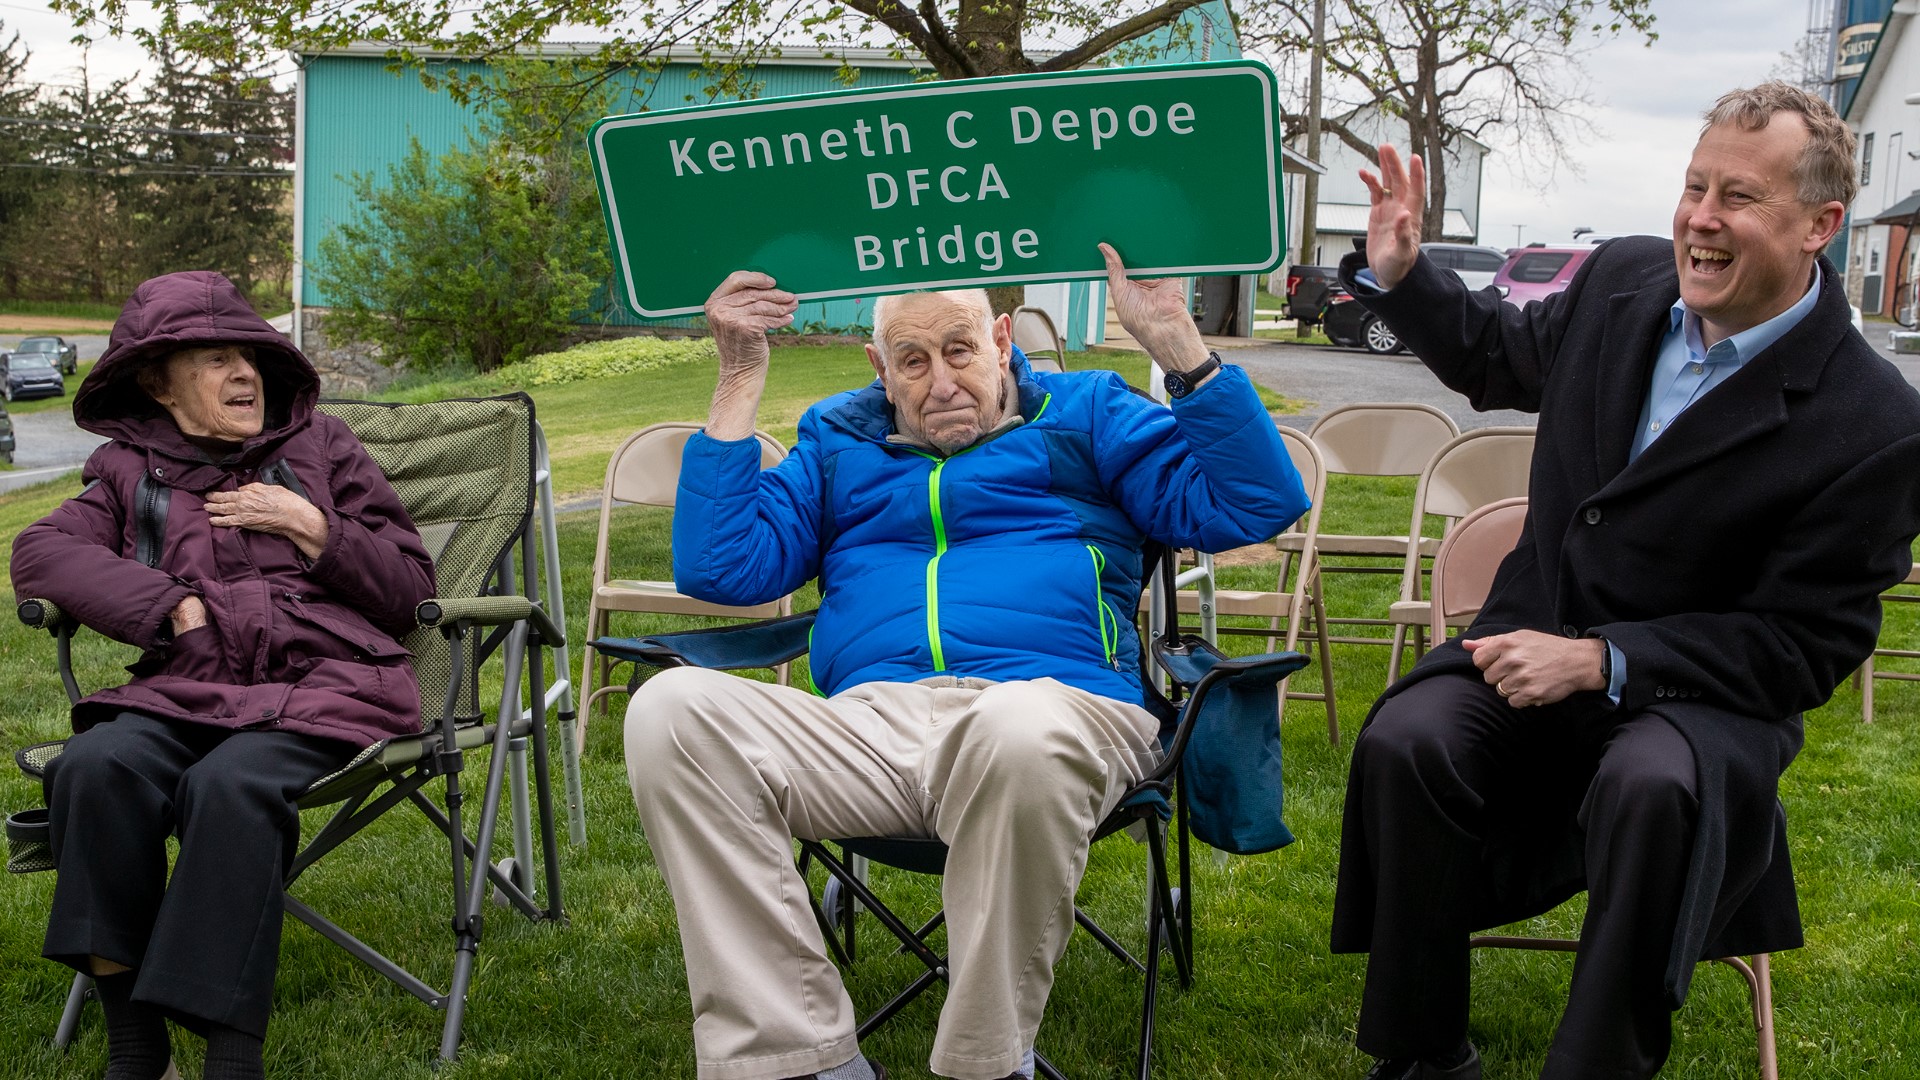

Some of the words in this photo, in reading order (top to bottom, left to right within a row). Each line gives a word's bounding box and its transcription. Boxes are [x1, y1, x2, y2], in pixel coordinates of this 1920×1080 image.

[669, 114, 912, 177] Kenneth
[946, 110, 978, 149] C
[1010, 102, 1195, 150] Depoe
[866, 163, 1010, 210] DFCA
[854, 224, 1039, 272] Bridge
